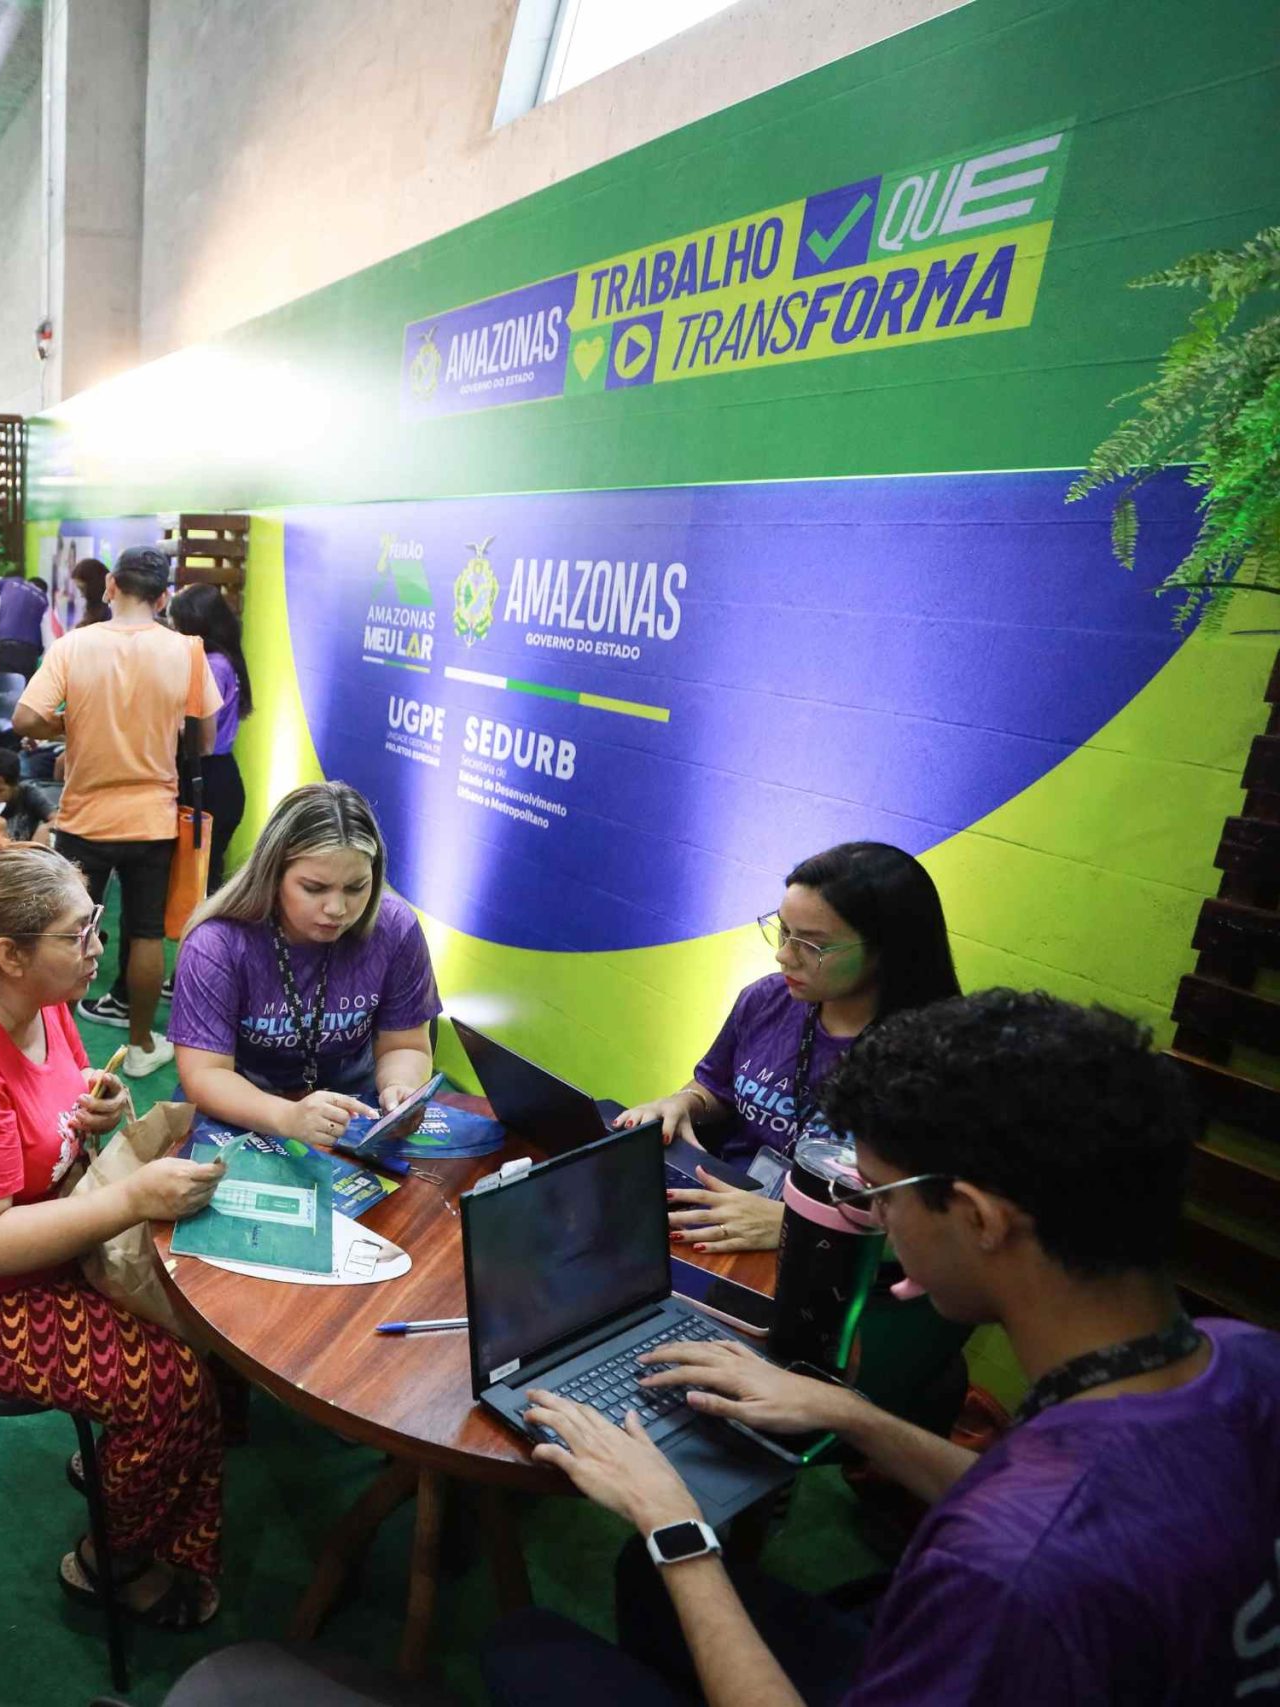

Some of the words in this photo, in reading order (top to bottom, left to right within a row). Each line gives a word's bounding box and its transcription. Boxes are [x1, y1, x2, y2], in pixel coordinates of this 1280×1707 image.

[590, 216, 784, 320] TRABALHO
[877, 132, 1064, 251] QUE
[671, 243, 1017, 371] TRANSFORMA
[445, 305, 563, 383] AMAZONAS
[367, 604, 436, 631] AMAZONAS
[503, 558, 688, 641] AMAZONAS
[525, 631, 575, 651] GOVERNO
[576, 639, 594, 654] DO
[594, 641, 641, 660] ESTADO
[388, 695, 447, 742] UGPE
[463, 715, 577, 781] SEDURB
[490, 796, 550, 829] Metropolitano
[494, 781, 568, 818] Desenvolvimento
[339, 993, 380, 1010] DOS
[739, 1059, 752, 1072] A
